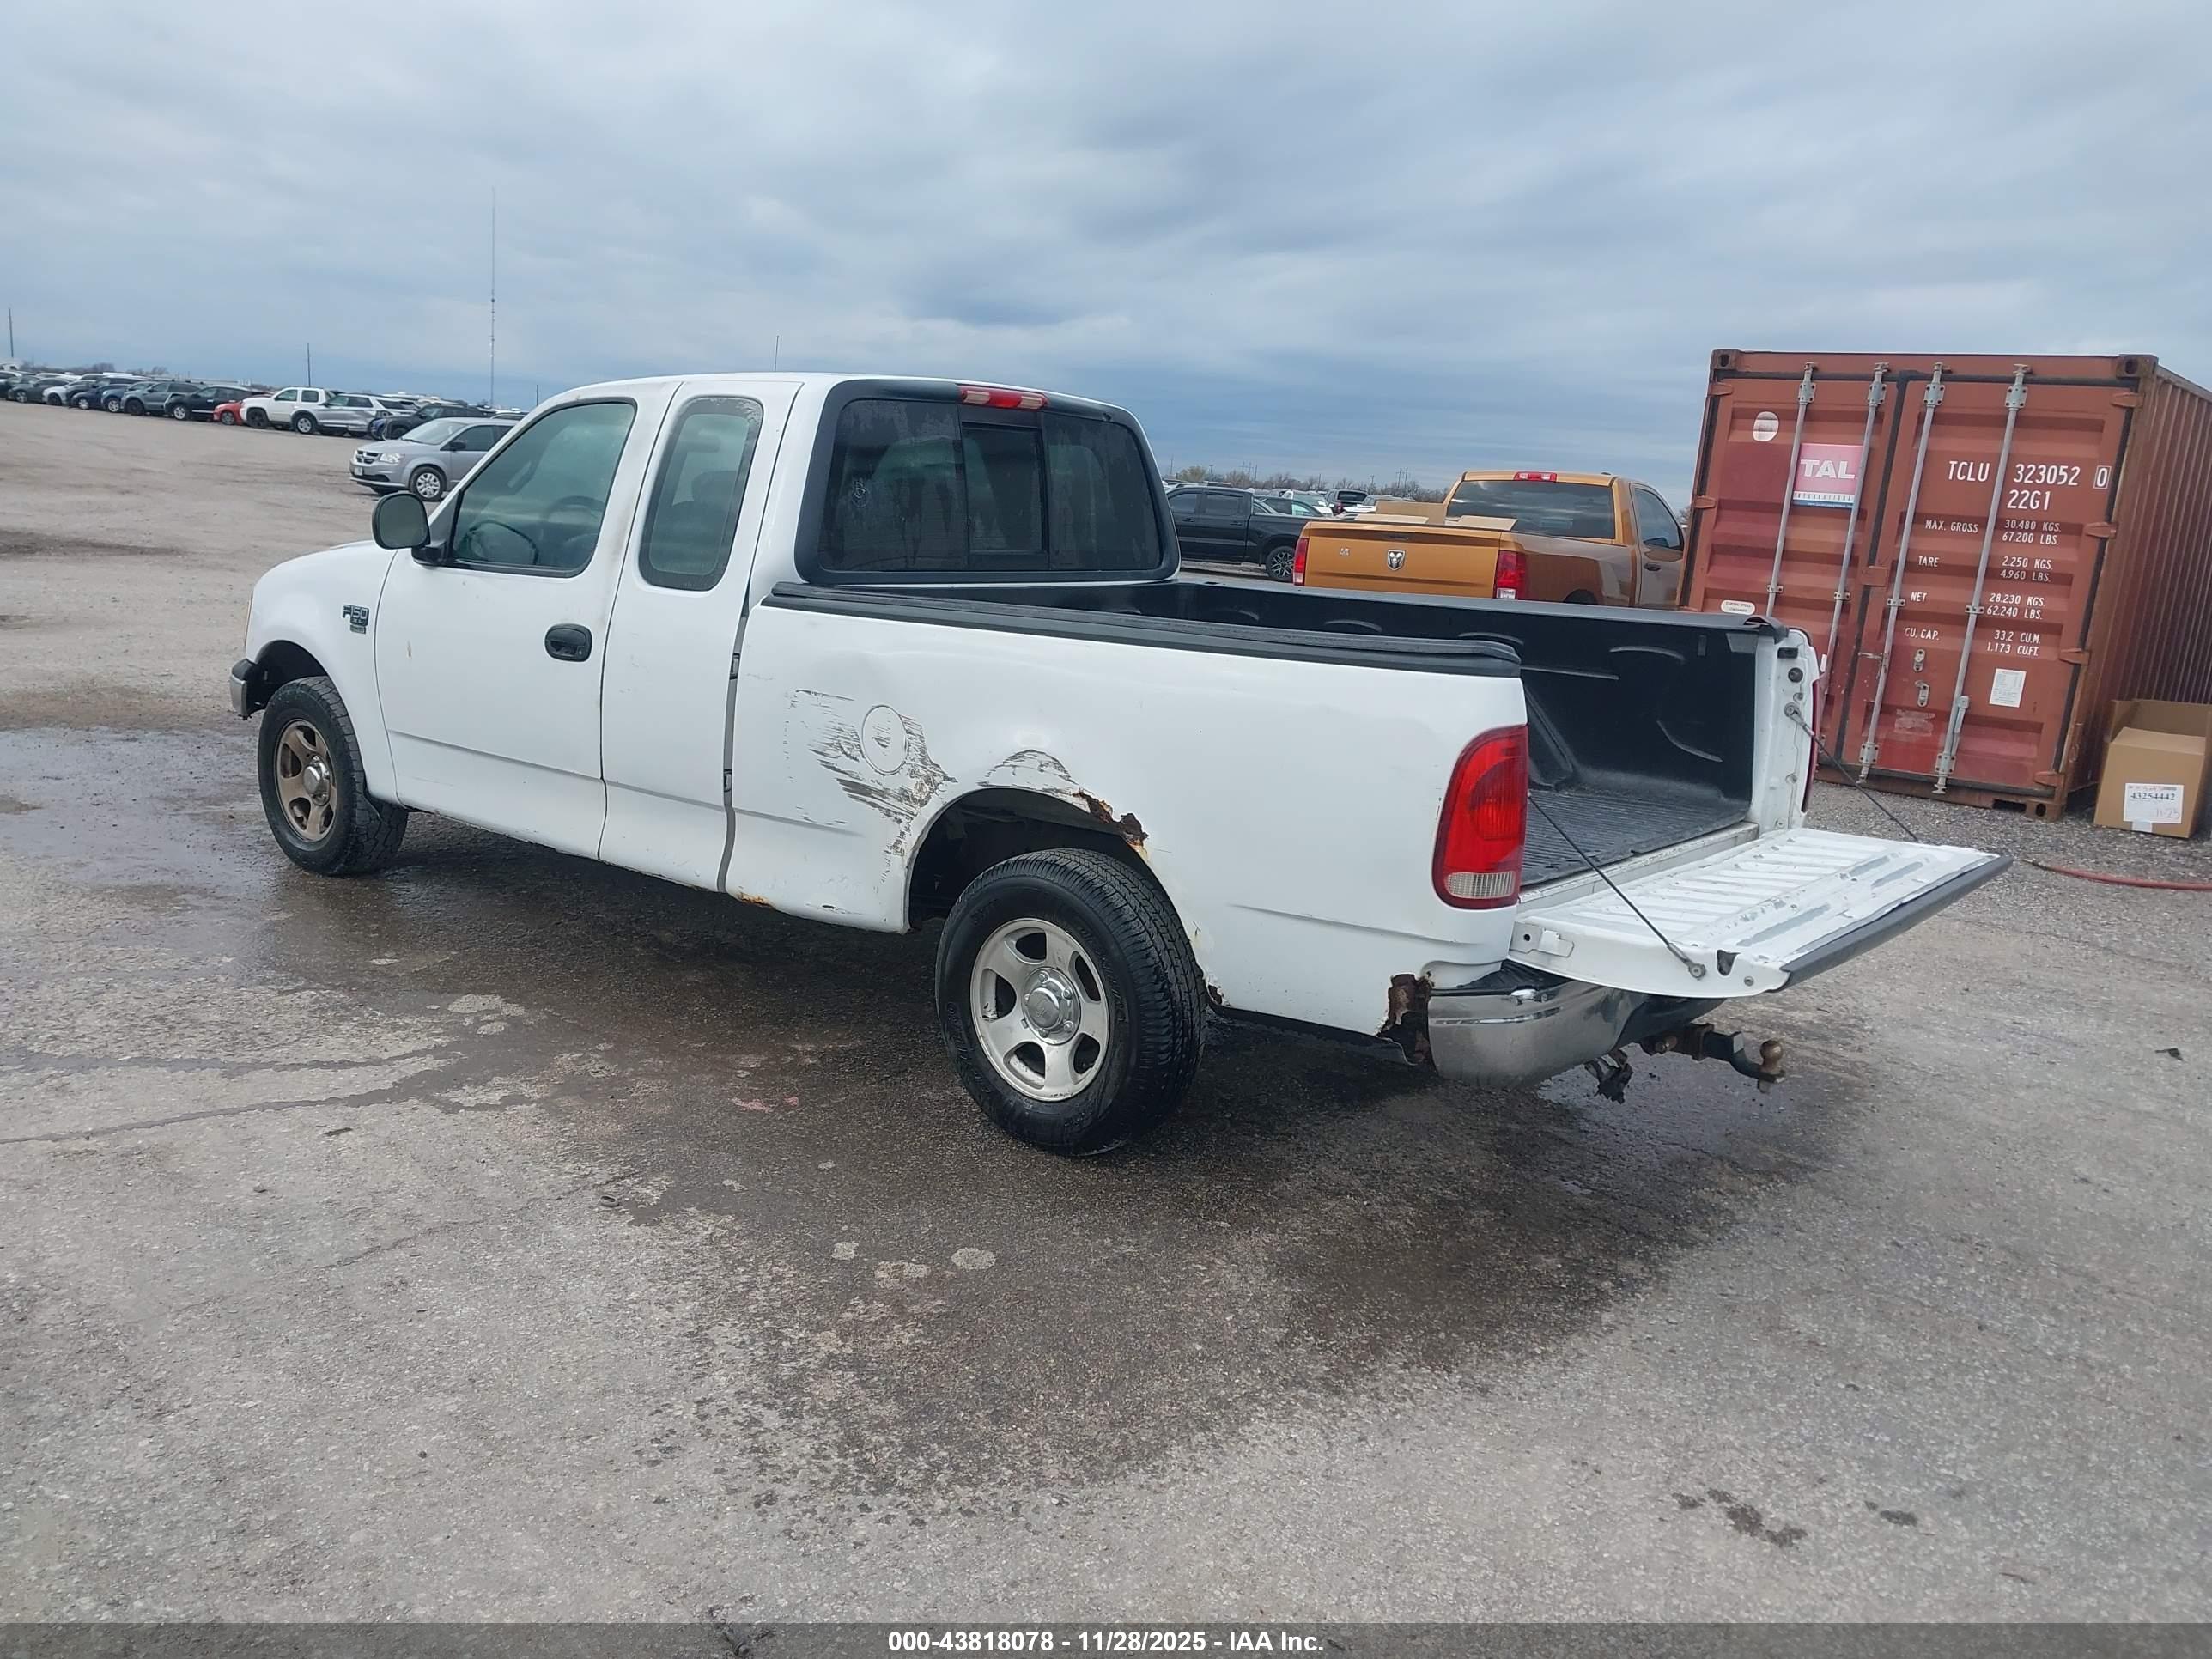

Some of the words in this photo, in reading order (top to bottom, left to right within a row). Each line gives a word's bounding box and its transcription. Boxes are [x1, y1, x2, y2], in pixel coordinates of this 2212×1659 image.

[1800, 459, 1856, 479] TAL
[1948, 460, 1990, 482] TCLU
[2013, 463, 2081, 486] 323052
[2096, 467, 2107, 487] 0
[2007, 489, 2051, 511] 22G1
[1925, 520, 1947, 531] MAX.
[1950, 521, 1979, 533] GROSS
[2005, 519, 2037, 531] 30.480
[2002, 532, 2034, 544] 67.200
[2039, 535, 2059, 545] LBS.
[1918, 556, 1940, 568] TARE
[2002, 556, 2028, 568] 2.250
[2000, 569, 2027, 580] 4.960
[1911, 592, 1927, 602] NET
[1989, 592, 2021, 605] 28.230
[1986, 605, 2018, 617] 62.240
[1920, 629, 1940, 641] CAP.
[1986, 642, 2011, 653] 1.173
